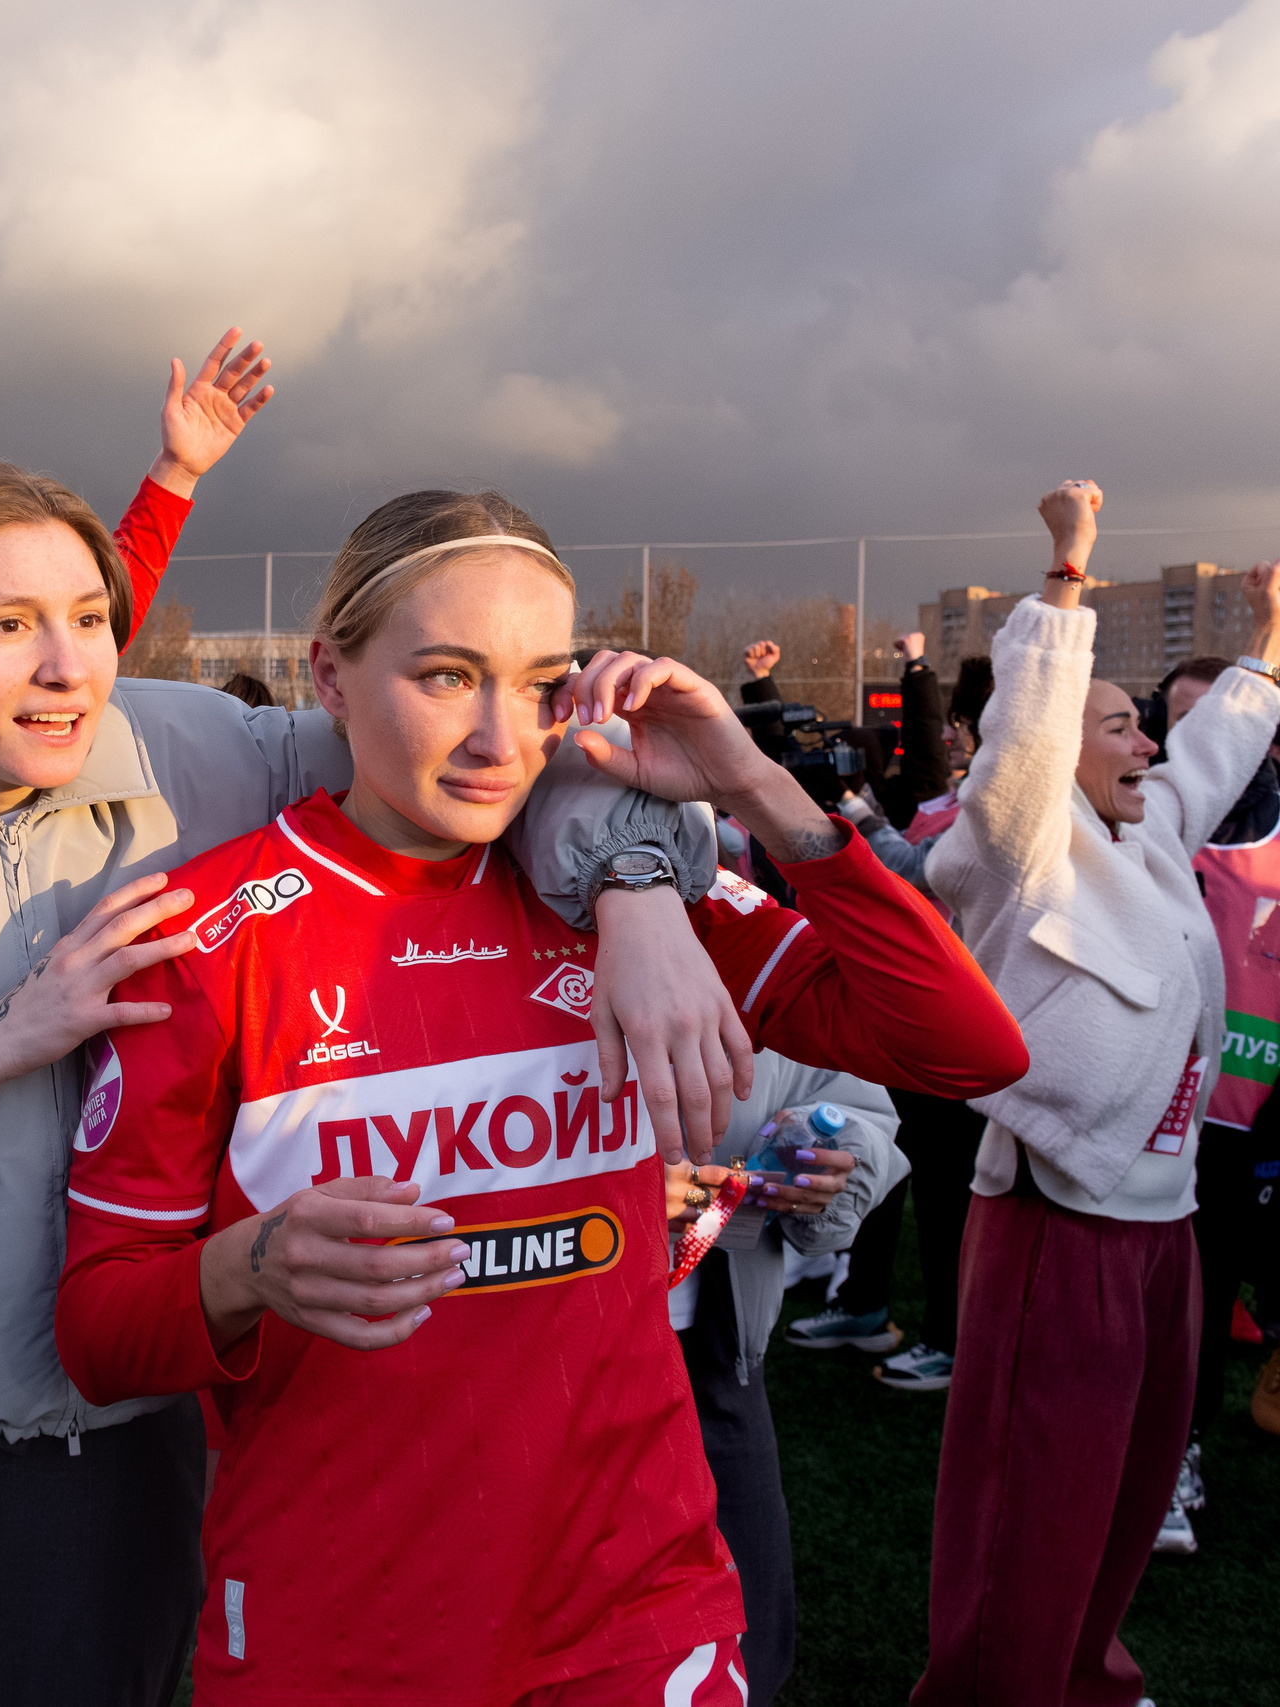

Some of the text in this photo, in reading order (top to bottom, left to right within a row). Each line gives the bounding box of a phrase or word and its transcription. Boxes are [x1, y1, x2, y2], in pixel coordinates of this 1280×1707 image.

[299, 1041, 380, 1066] JÖGEL
[1221, 1031, 1280, 1067] ЛУБ
[311, 1070, 637, 1187] ЛУКОЙЛ
[392, 1228, 576, 1282] NLINE
